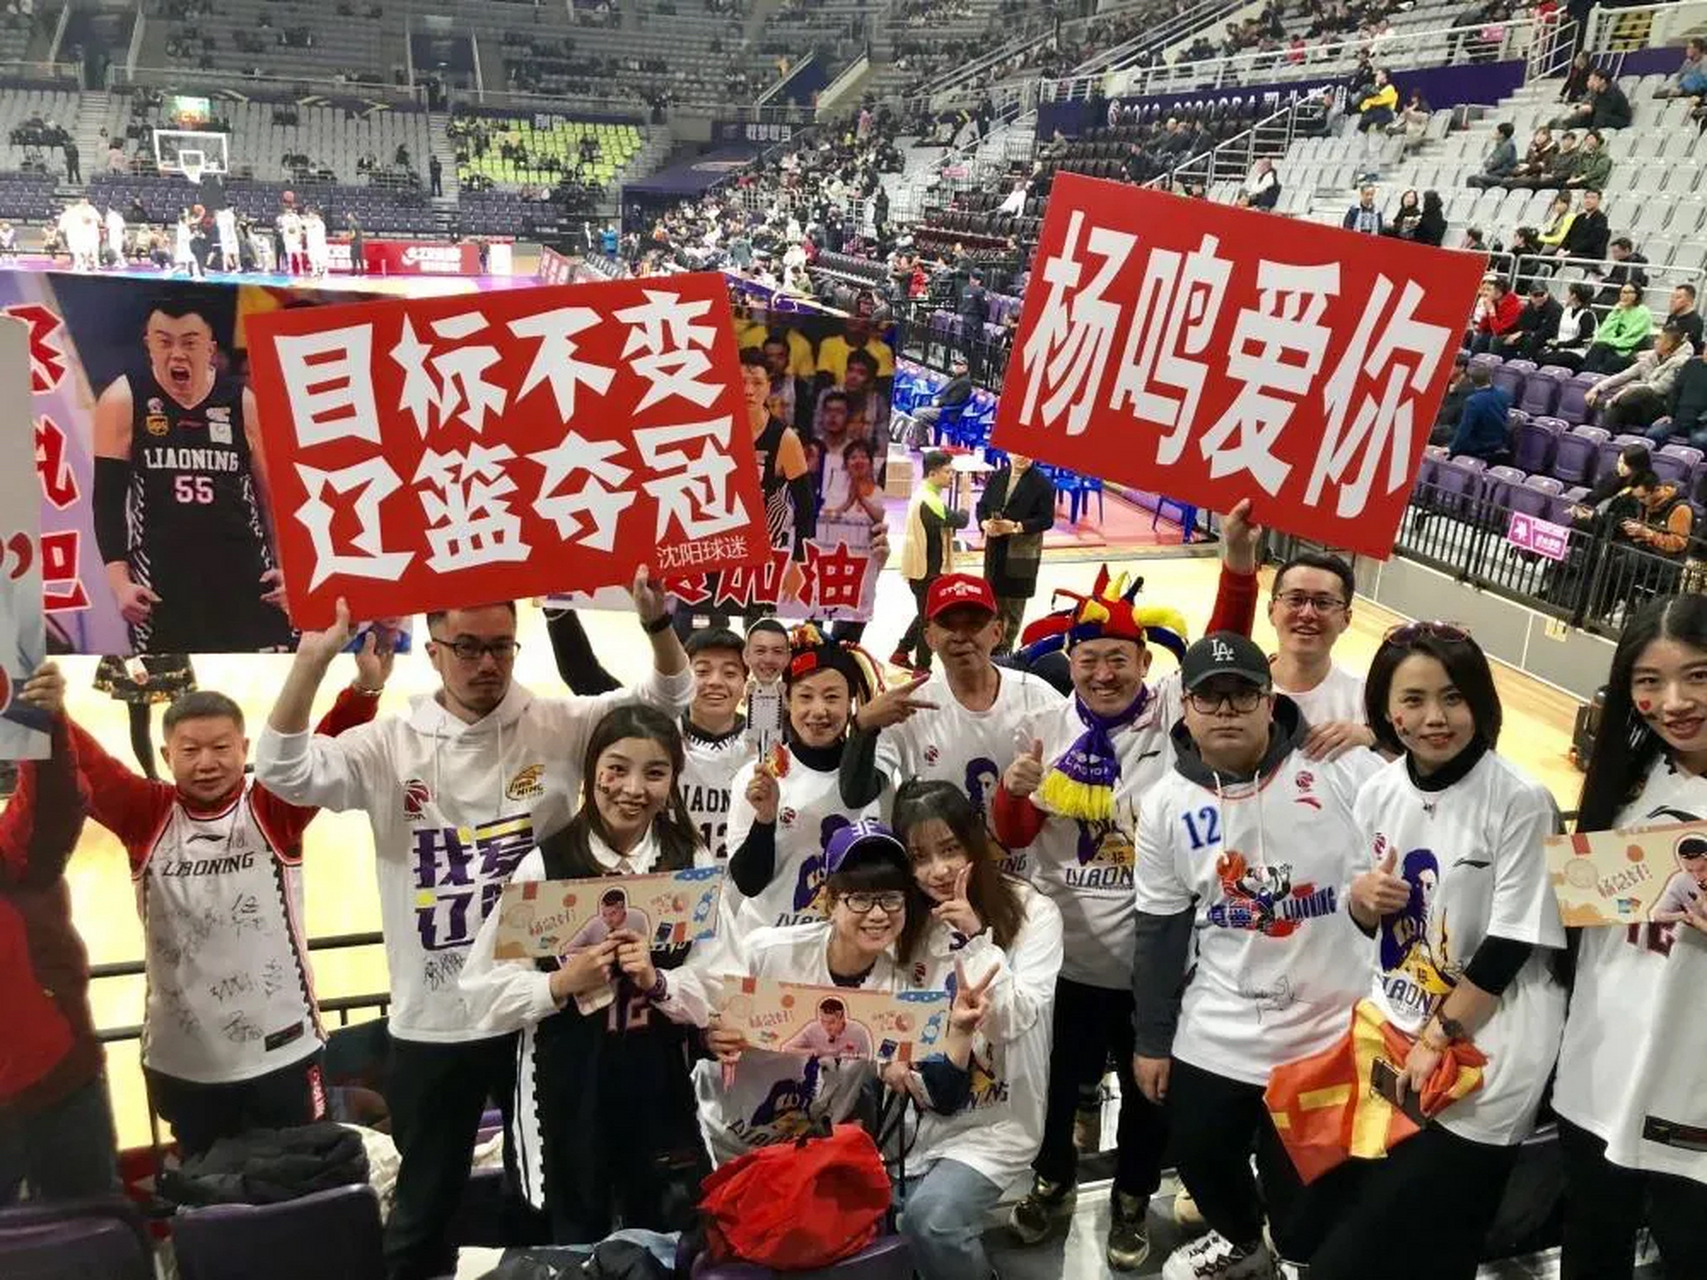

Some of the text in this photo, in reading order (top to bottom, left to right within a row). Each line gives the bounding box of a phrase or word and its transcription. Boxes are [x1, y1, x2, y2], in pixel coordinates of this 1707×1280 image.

[273, 289, 727, 448] 目标不变
[1019, 209, 1452, 518] 杨鸣爱你
[144, 447, 239, 472] LIAONING
[175, 475, 214, 504] 55
[293, 415, 750, 594] 辽篮夺冠
[656, 538, 749, 569] 沈阳球迷
[1211, 639, 1235, 662] LA
[1181, 805, 1221, 850] 12
[413, 813, 534, 888] 我爱
